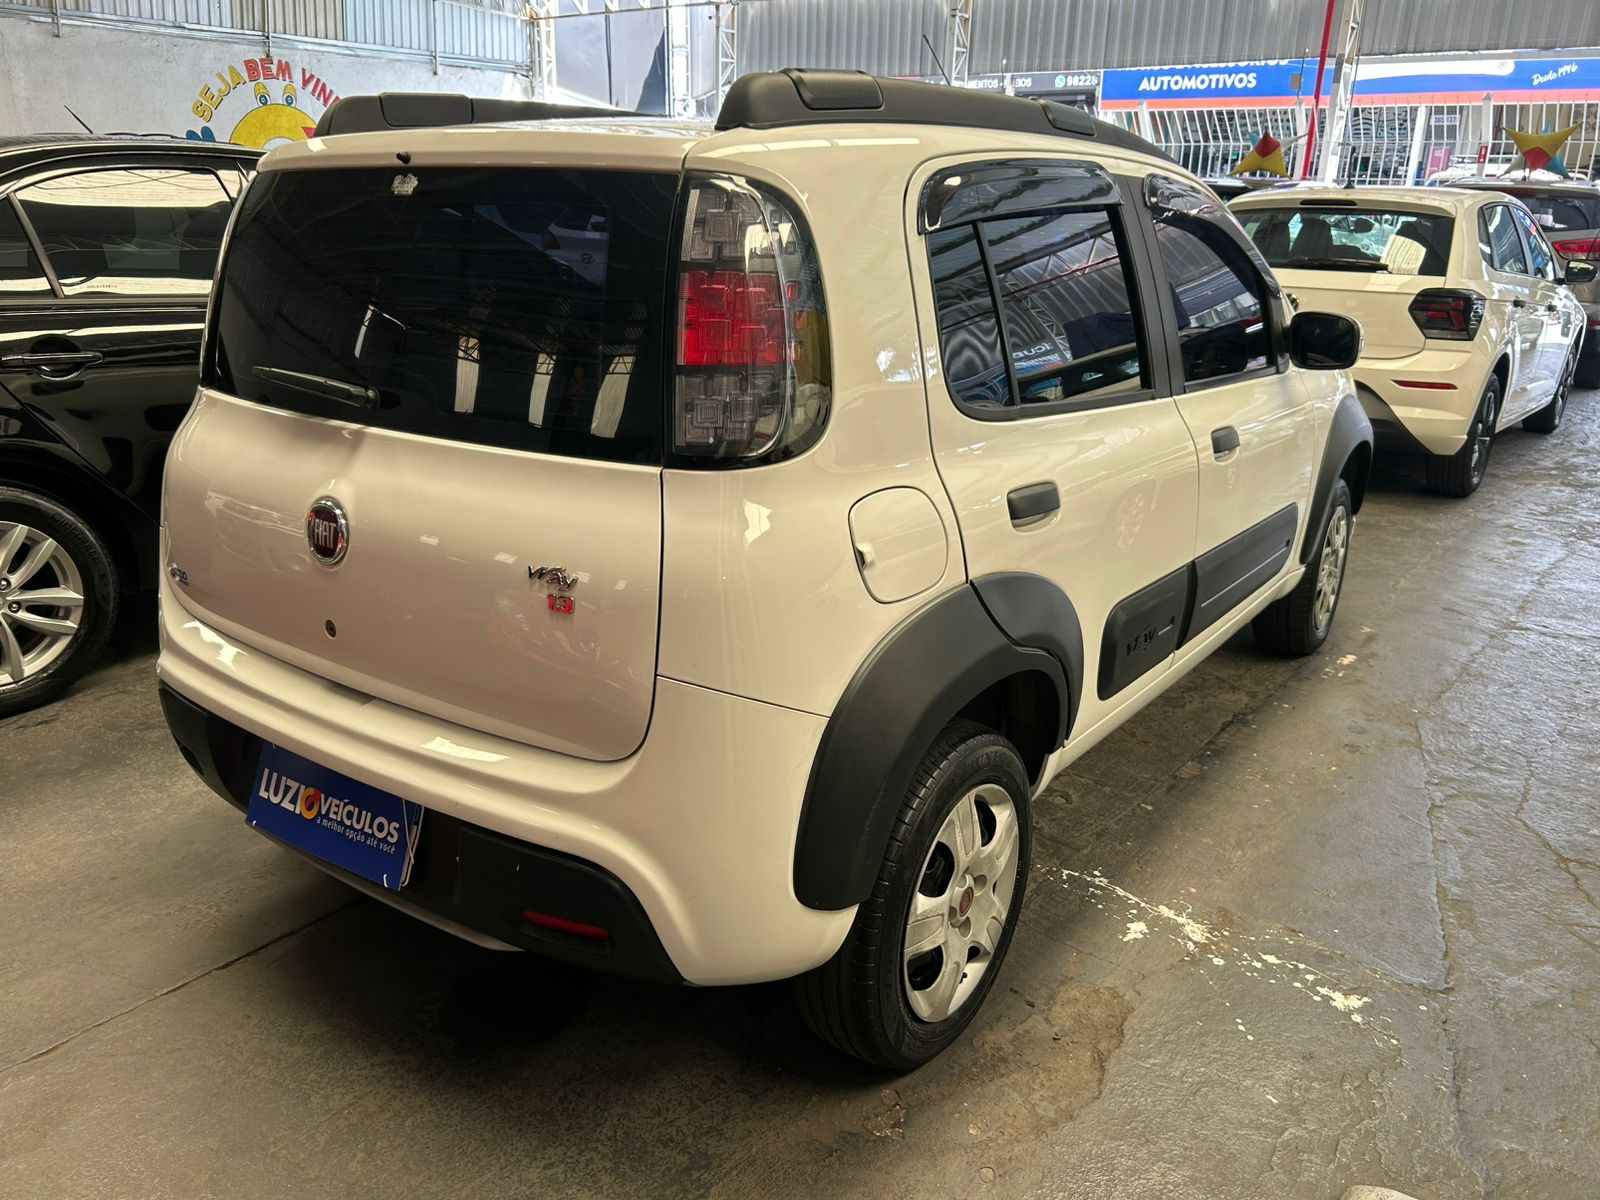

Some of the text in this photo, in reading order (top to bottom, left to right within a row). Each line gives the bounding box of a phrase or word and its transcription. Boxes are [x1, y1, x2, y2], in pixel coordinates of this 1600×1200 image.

[191, 64, 247, 123] SEJA
[243, 57, 294, 83] BEM
[1138, 73, 1257, 92] AUTOMOTIVOS
[314, 518, 337, 549] FIAT
[322, 818, 345, 834] melhor
[345, 828, 365, 842] opção
[366, 837, 378, 848] até
[379, 842, 396, 855] você
